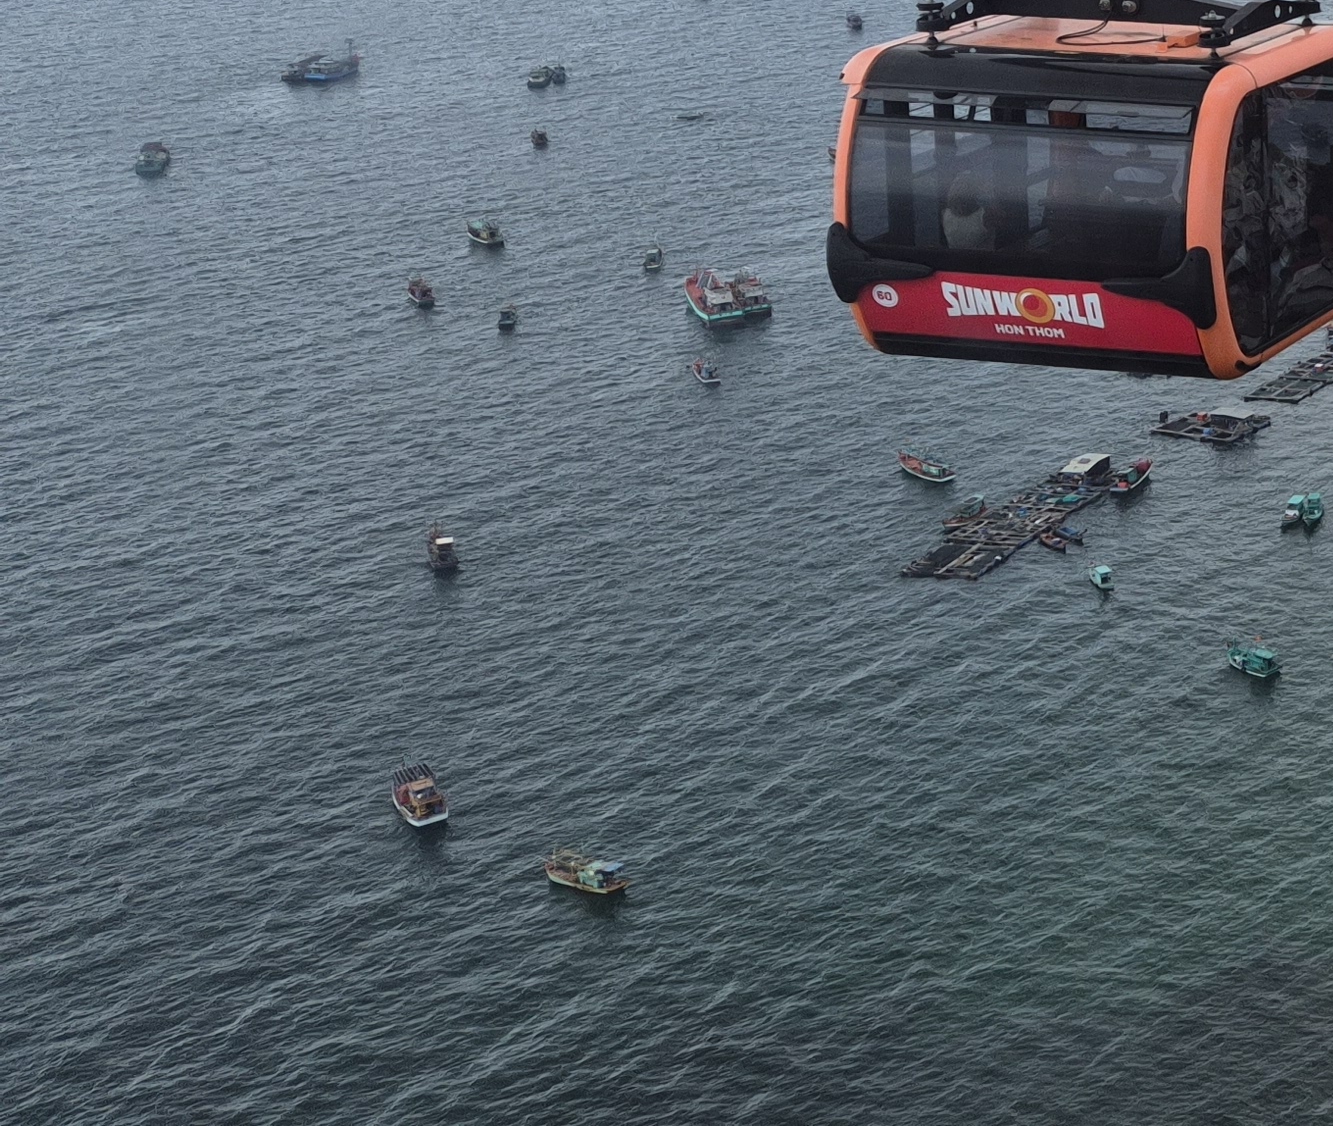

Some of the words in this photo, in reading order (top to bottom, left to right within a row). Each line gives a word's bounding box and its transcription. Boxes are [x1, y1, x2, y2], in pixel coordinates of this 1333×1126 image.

[876, 290, 892, 301] 60
[994, 323, 1025, 336] HON
[1025, 325, 1066, 339] THOM
